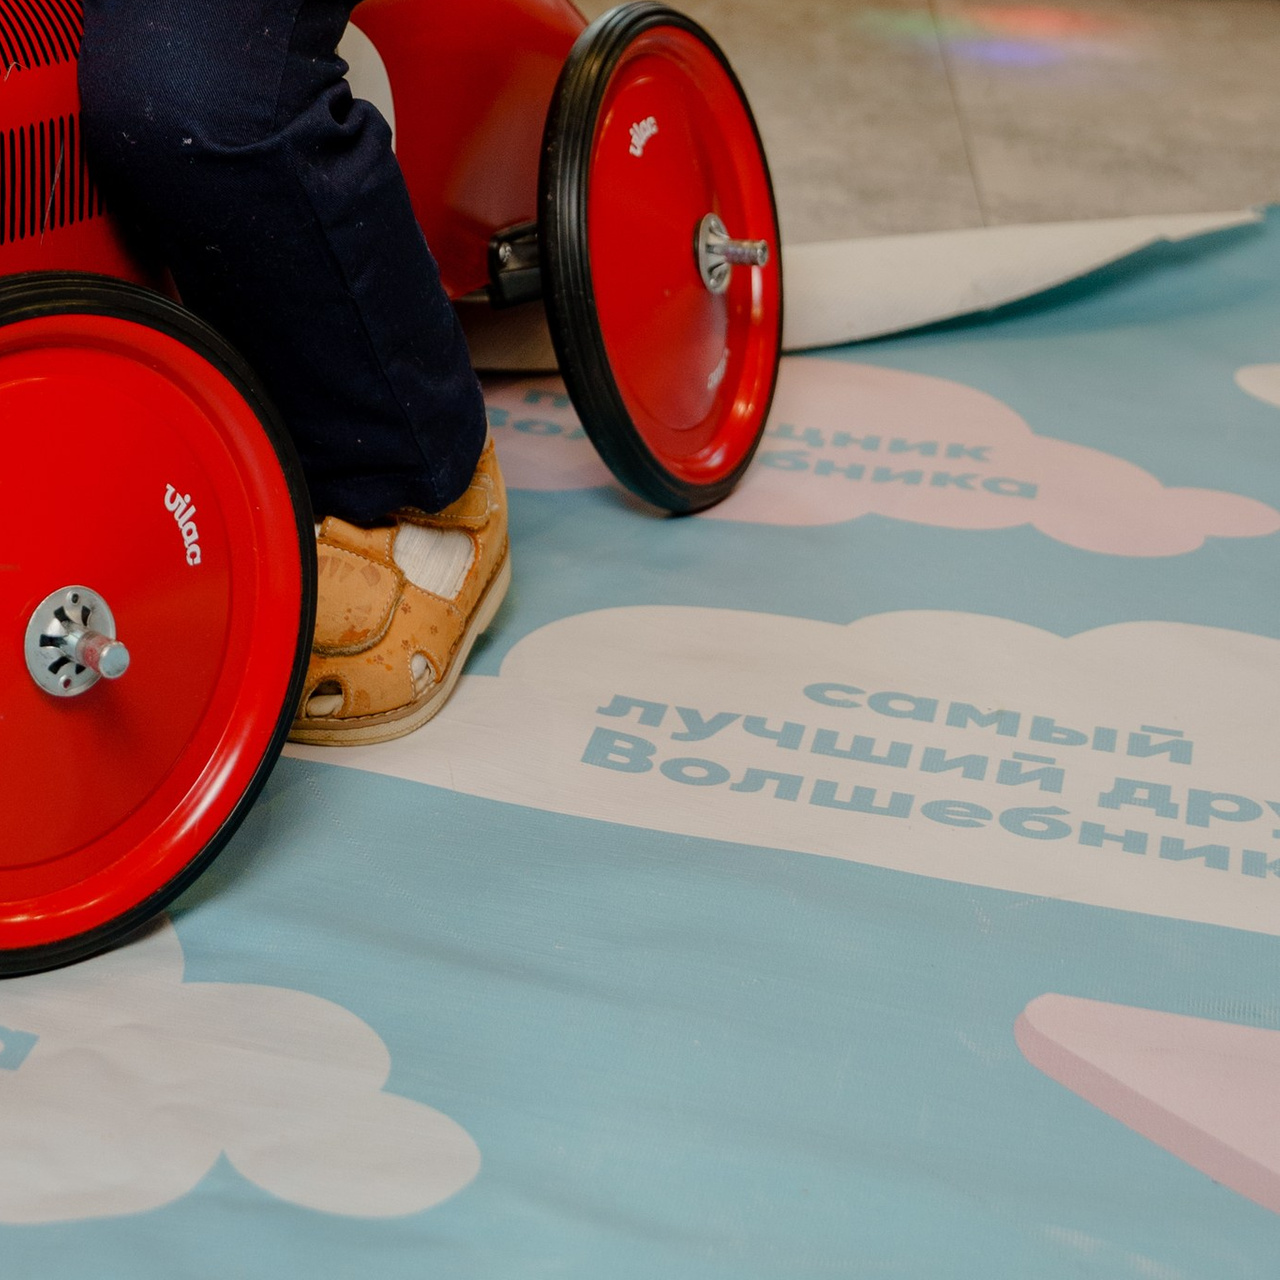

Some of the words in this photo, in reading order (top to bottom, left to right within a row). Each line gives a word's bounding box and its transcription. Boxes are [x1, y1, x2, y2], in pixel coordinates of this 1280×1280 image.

[164, 483, 201, 566] vilac
[803, 682, 1193, 765] самый
[595, 694, 1065, 794] лучший
[1097, 777, 1280, 838] др
